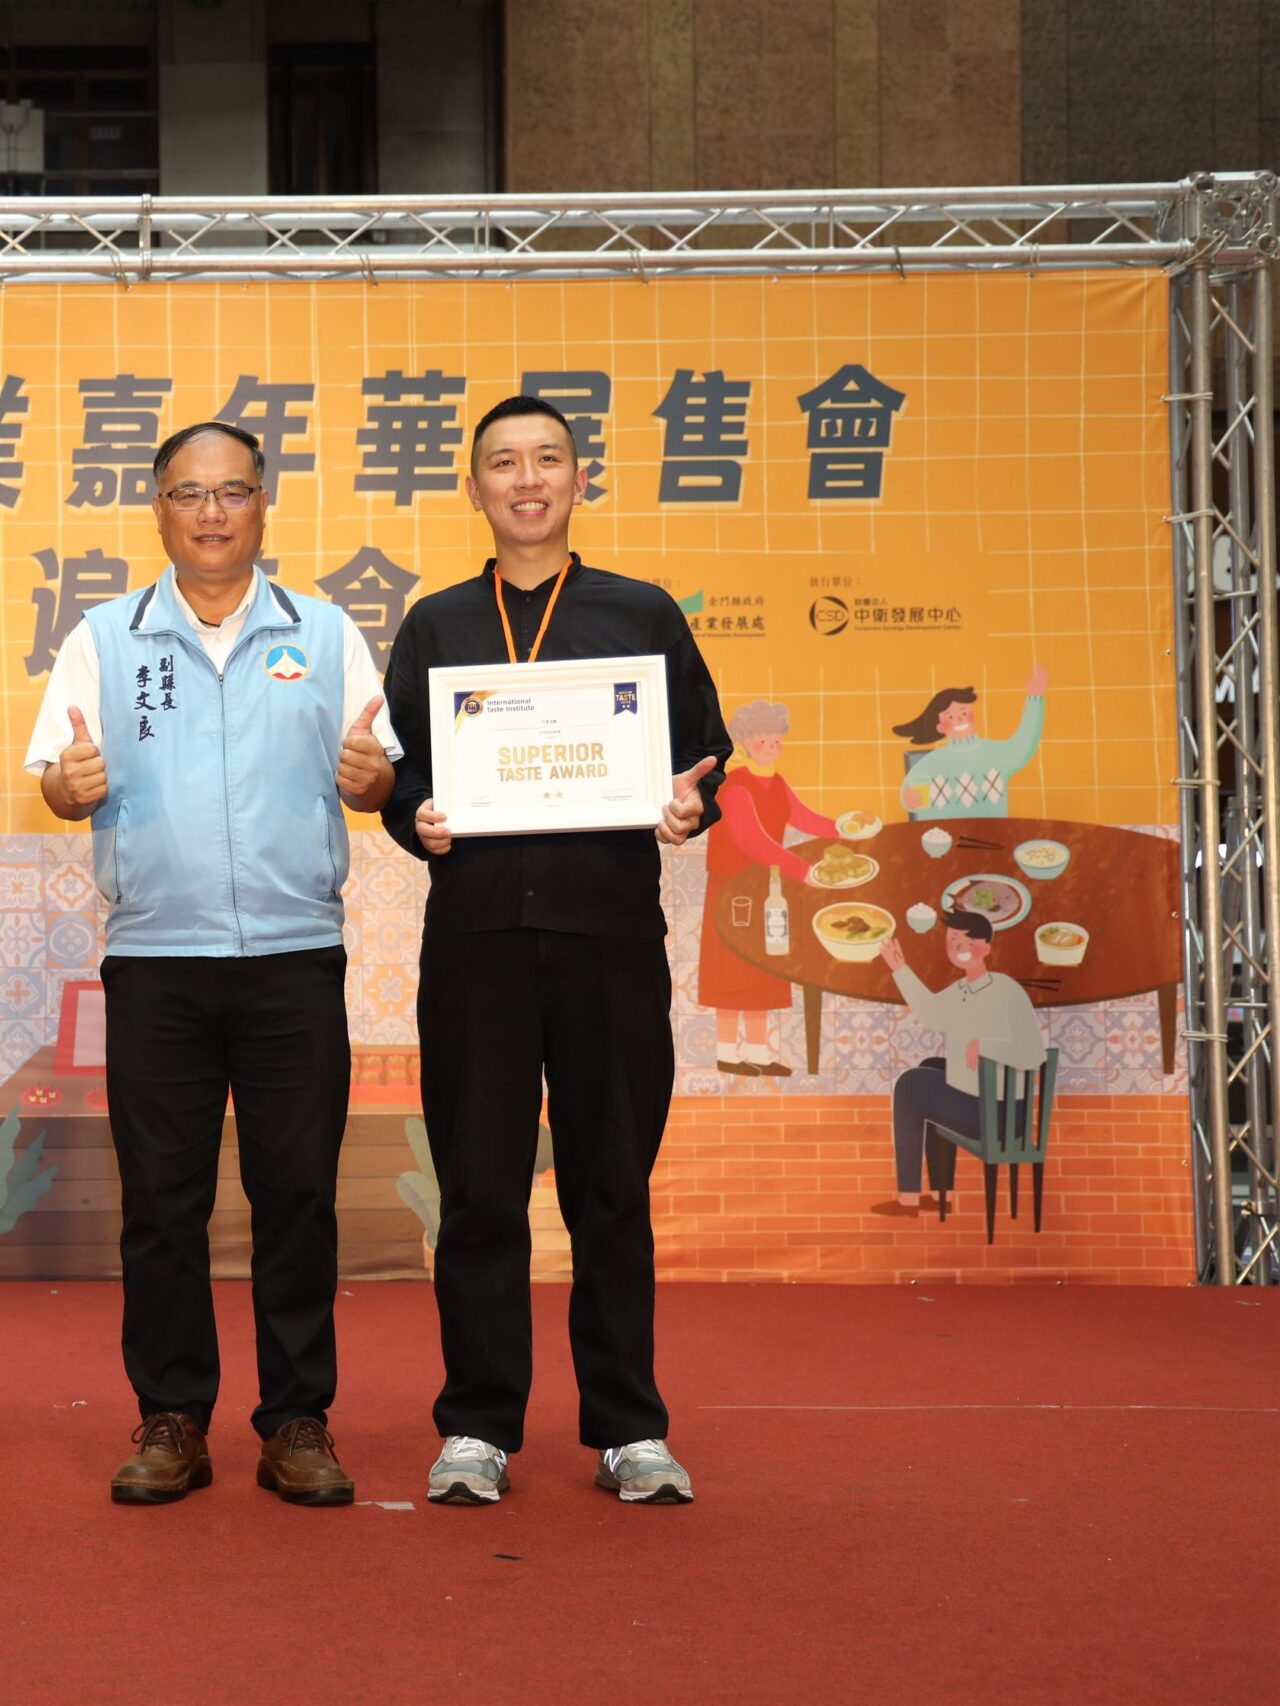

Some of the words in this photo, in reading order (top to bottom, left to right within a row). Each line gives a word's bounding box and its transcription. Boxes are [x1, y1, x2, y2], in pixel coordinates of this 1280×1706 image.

[816, 610, 845, 622] CSD
[854, 608, 962, 624] 中衛發展中心
[158, 654, 178, 711] 副縣長
[133, 665, 158, 742] 李文良
[487, 698, 532, 706] International
[615, 694, 636, 702] TASTE
[498, 743, 605, 766] SUPERIOR
[496, 766, 543, 782] TASTE
[549, 763, 608, 780] AWARD
